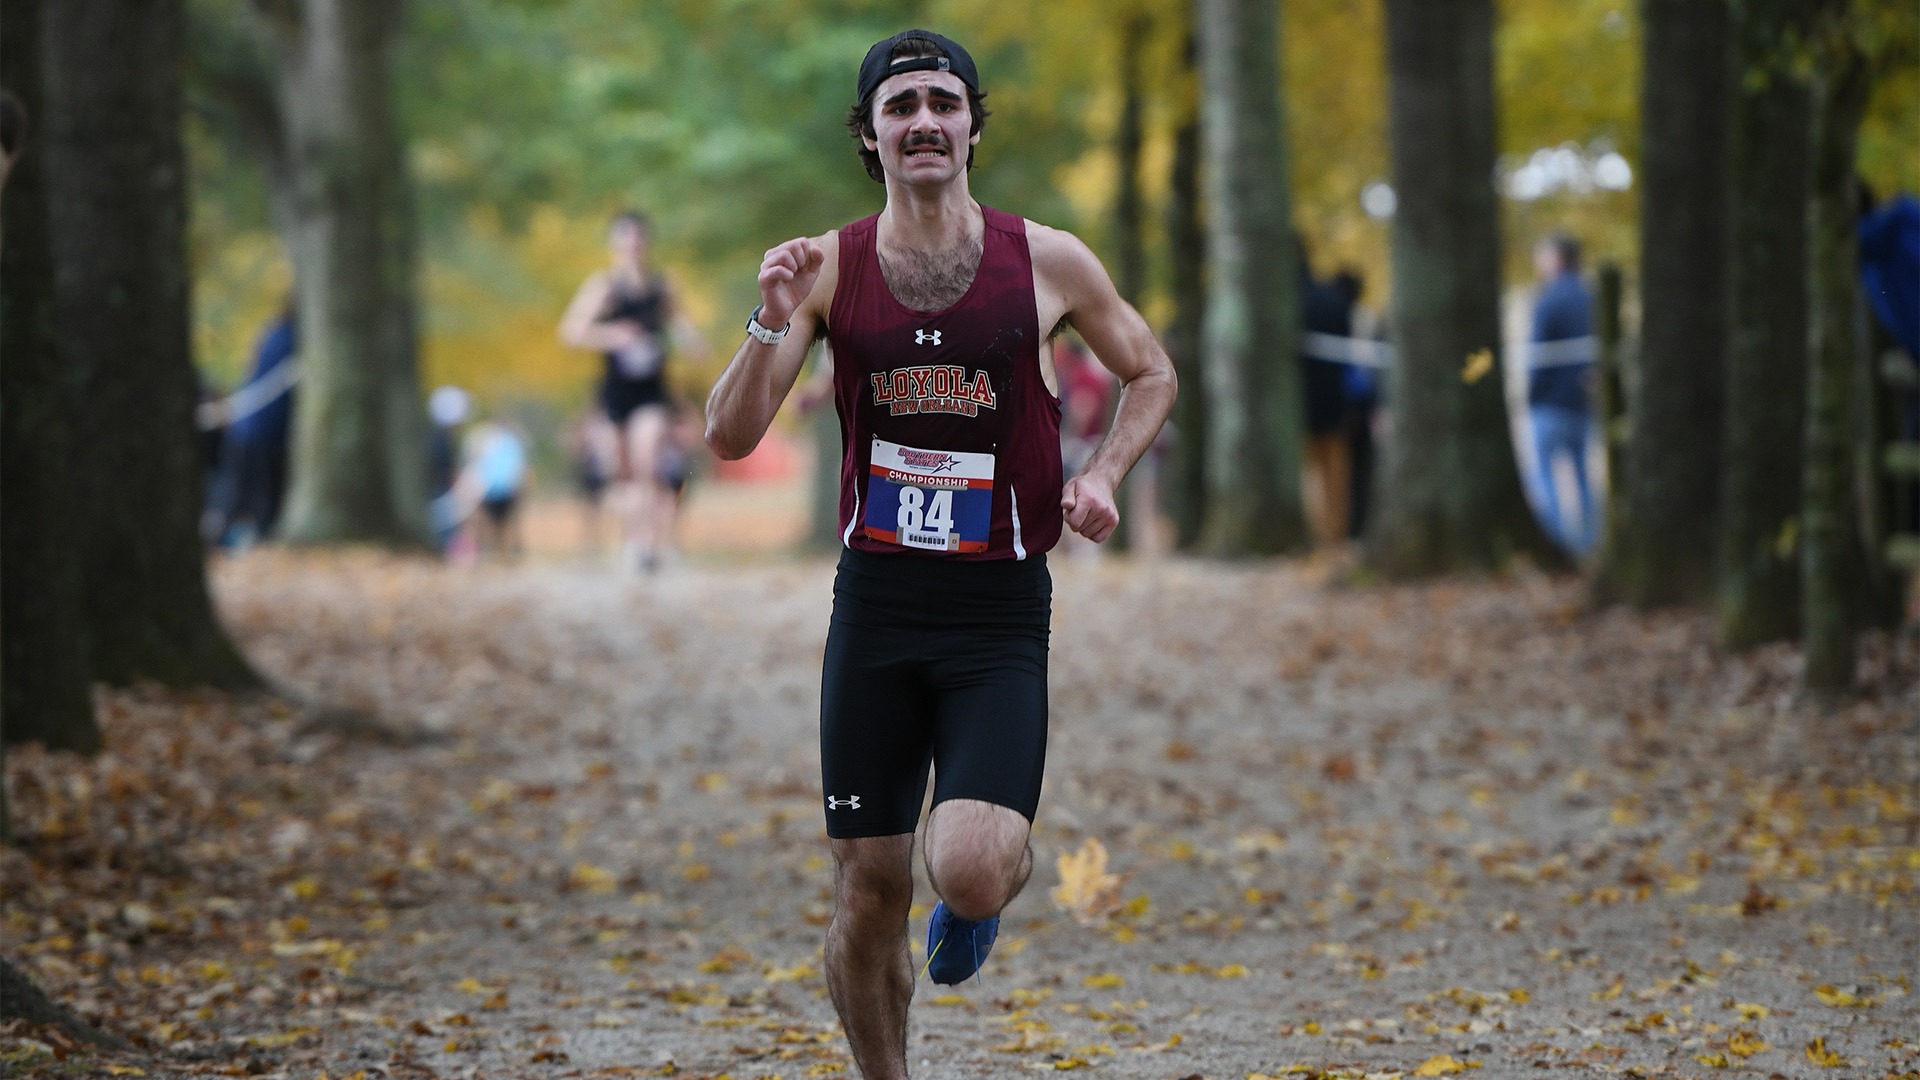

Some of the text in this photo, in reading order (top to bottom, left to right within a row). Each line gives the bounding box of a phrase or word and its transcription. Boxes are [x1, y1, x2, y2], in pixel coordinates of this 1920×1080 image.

[872, 366, 995, 408] LOYOLA
[891, 399, 977, 416] NEW ORLEANS
[898, 448, 948, 461] SOUTHERN
[904, 458, 939, 467] STATES
[889, 471, 969, 486] CHAMPIONSHIP
[897, 486, 954, 533] 84
